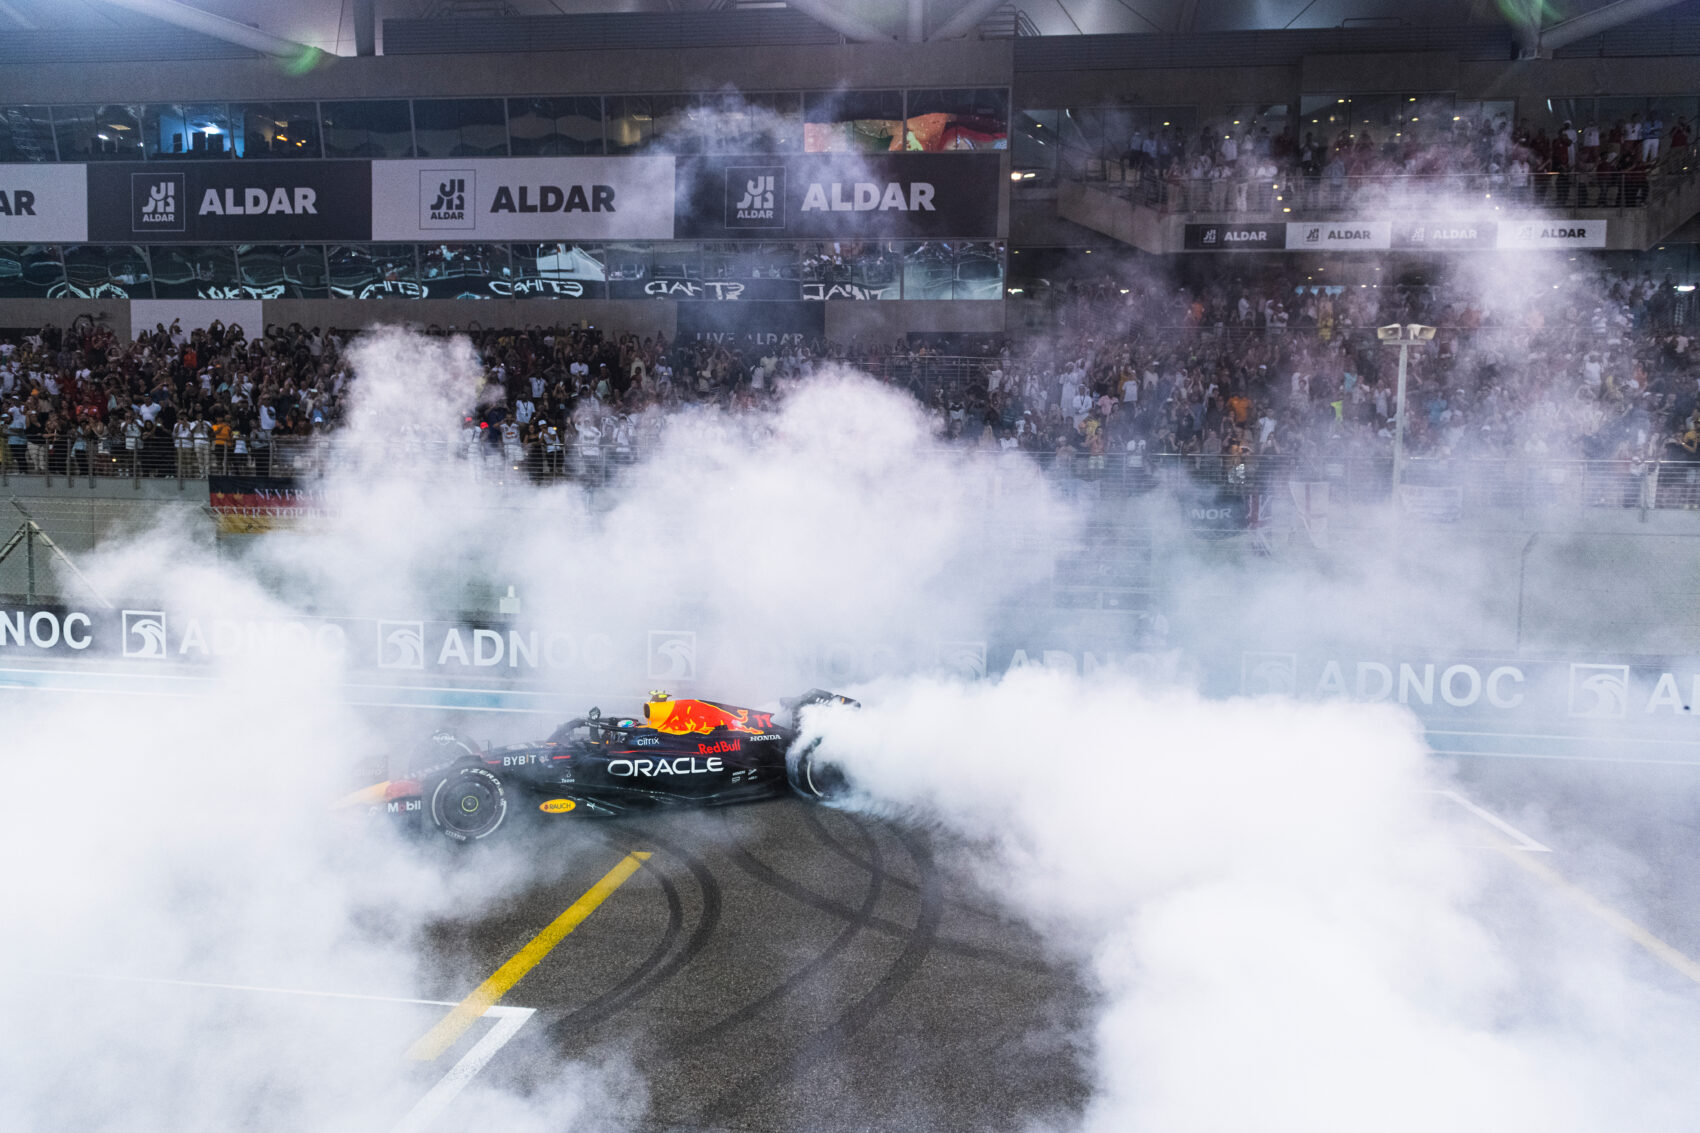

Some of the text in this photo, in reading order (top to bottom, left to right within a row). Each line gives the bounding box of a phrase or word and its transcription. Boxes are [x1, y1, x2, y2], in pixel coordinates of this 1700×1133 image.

[199, 188, 317, 215] ALDAR
[490, 185, 616, 213] ALDAR
[801, 182, 936, 211] ALDAR
[142, 214, 175, 222] ALDAR
[430, 212, 464, 220] ALDAR
[736, 210, 773, 219] ALDAR
[1224, 231, 1267, 241] ALDAR
[1328, 230, 1371, 239] ALDAR
[1432, 229, 1477, 239] ALDAR
[1540, 228, 1586, 238] ALDAR
[254, 488, 304, 501] NEVER
[1315, 660, 1525, 708] ADNOC
[752, 714, 774, 727] 11
[637, 737, 660, 746] citrix
[750, 734, 782, 742] HONDA
[697, 739, 741, 754] Red Bull
[503, 754, 537, 766] BYBIT
[607, 757, 725, 777] ORACLE
[387, 800, 421, 813] Mobil
[549, 802, 571, 810] RAUCH
